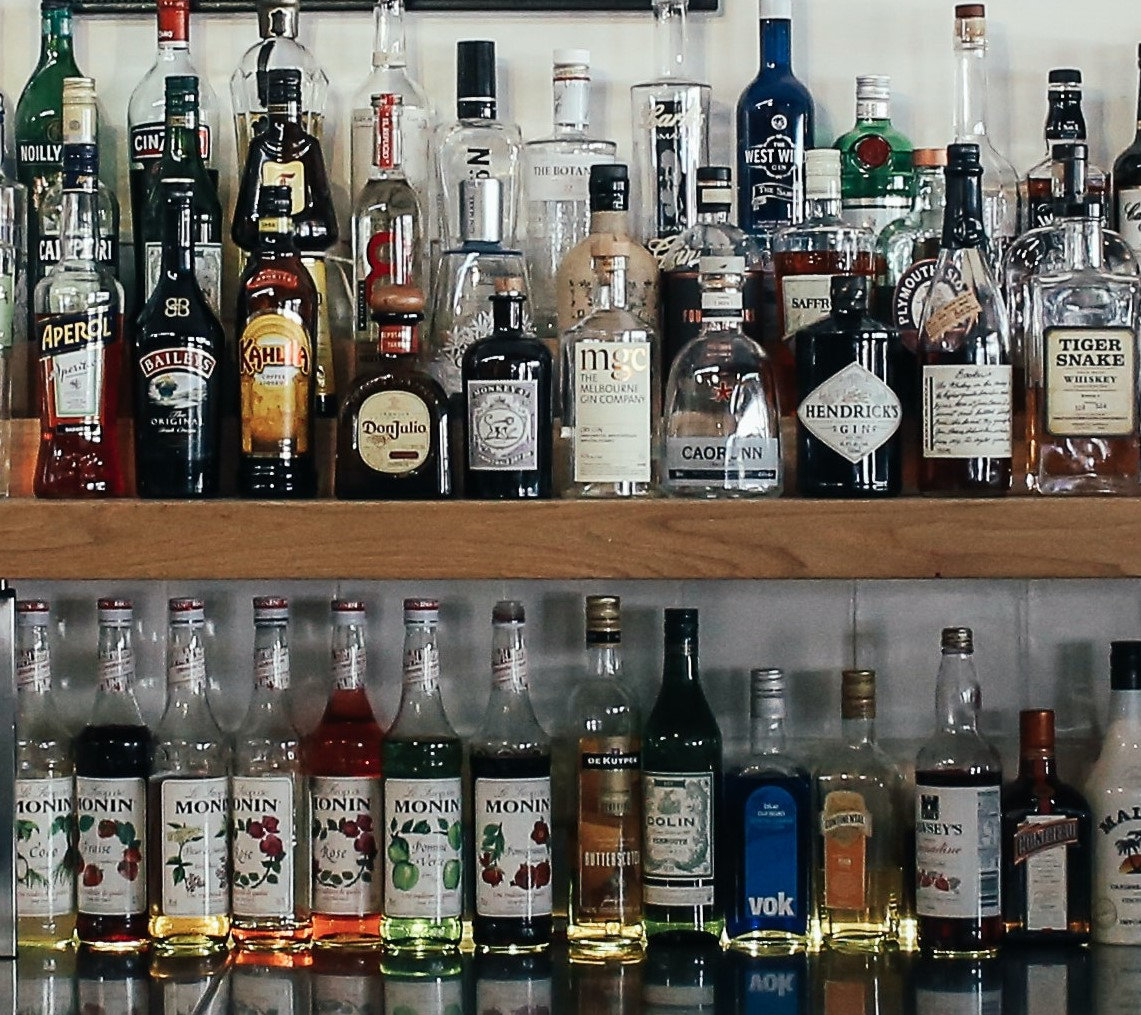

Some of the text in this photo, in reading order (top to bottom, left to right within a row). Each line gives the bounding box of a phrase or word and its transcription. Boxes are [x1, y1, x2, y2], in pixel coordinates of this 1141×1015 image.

[20, 144, 62, 162] NOILLY
[745, 149, 774, 163] WEST
[792, 297, 832, 310] SAFFR
[42, 316, 112, 351] APEROL
[1059, 338, 1122, 351] TIGER
[1056, 354, 1125, 367] SNAKE
[1064, 375, 1117, 384] WHISKEY
[805, 404, 899, 419] HENDRICK'S
[840, 425, 870, 434] GIN
[395, 800, 459, 814] MONIN
[485, 799, 550, 814] MONIN
[749, 891, 795, 917] vok
